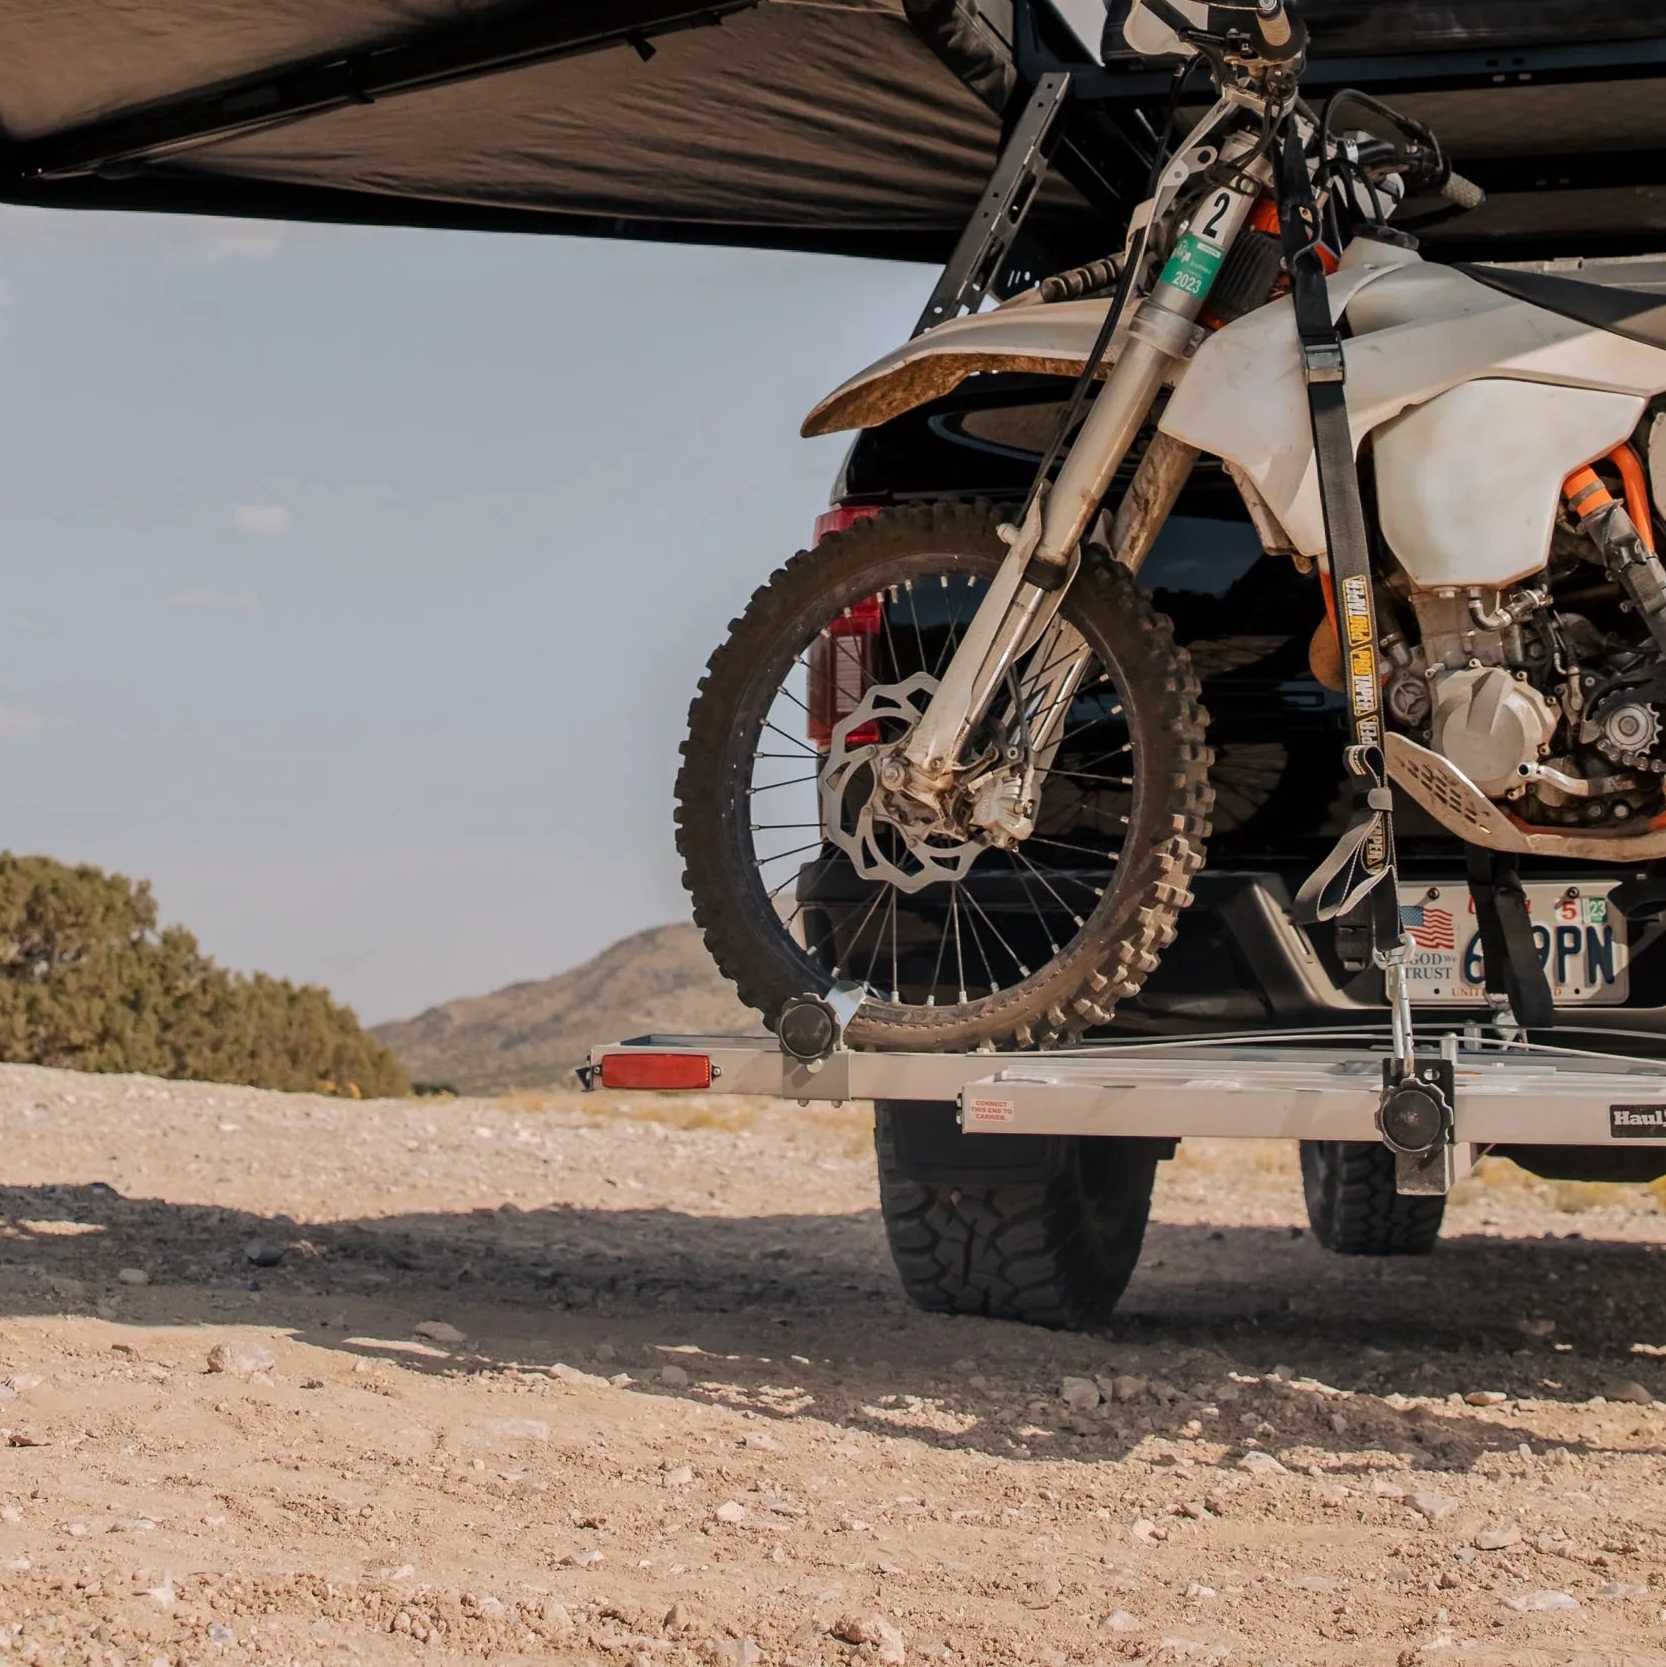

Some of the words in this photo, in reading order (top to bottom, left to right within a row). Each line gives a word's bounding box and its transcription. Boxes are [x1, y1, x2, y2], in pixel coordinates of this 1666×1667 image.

[1202, 192, 1231, 239] 2
[1172, 270, 1202, 294] 2023
[1562, 900, 1577, 920] 5
[1589, 900, 1607, 917] 23
[1409, 953, 1442, 966] GOD
[1464, 925, 1615, 985] 69PN
[1405, 967, 1454, 980] TRUST
[1451, 987, 1485, 997] UNIT
[1613, 1110, 1663, 1126] Haul
